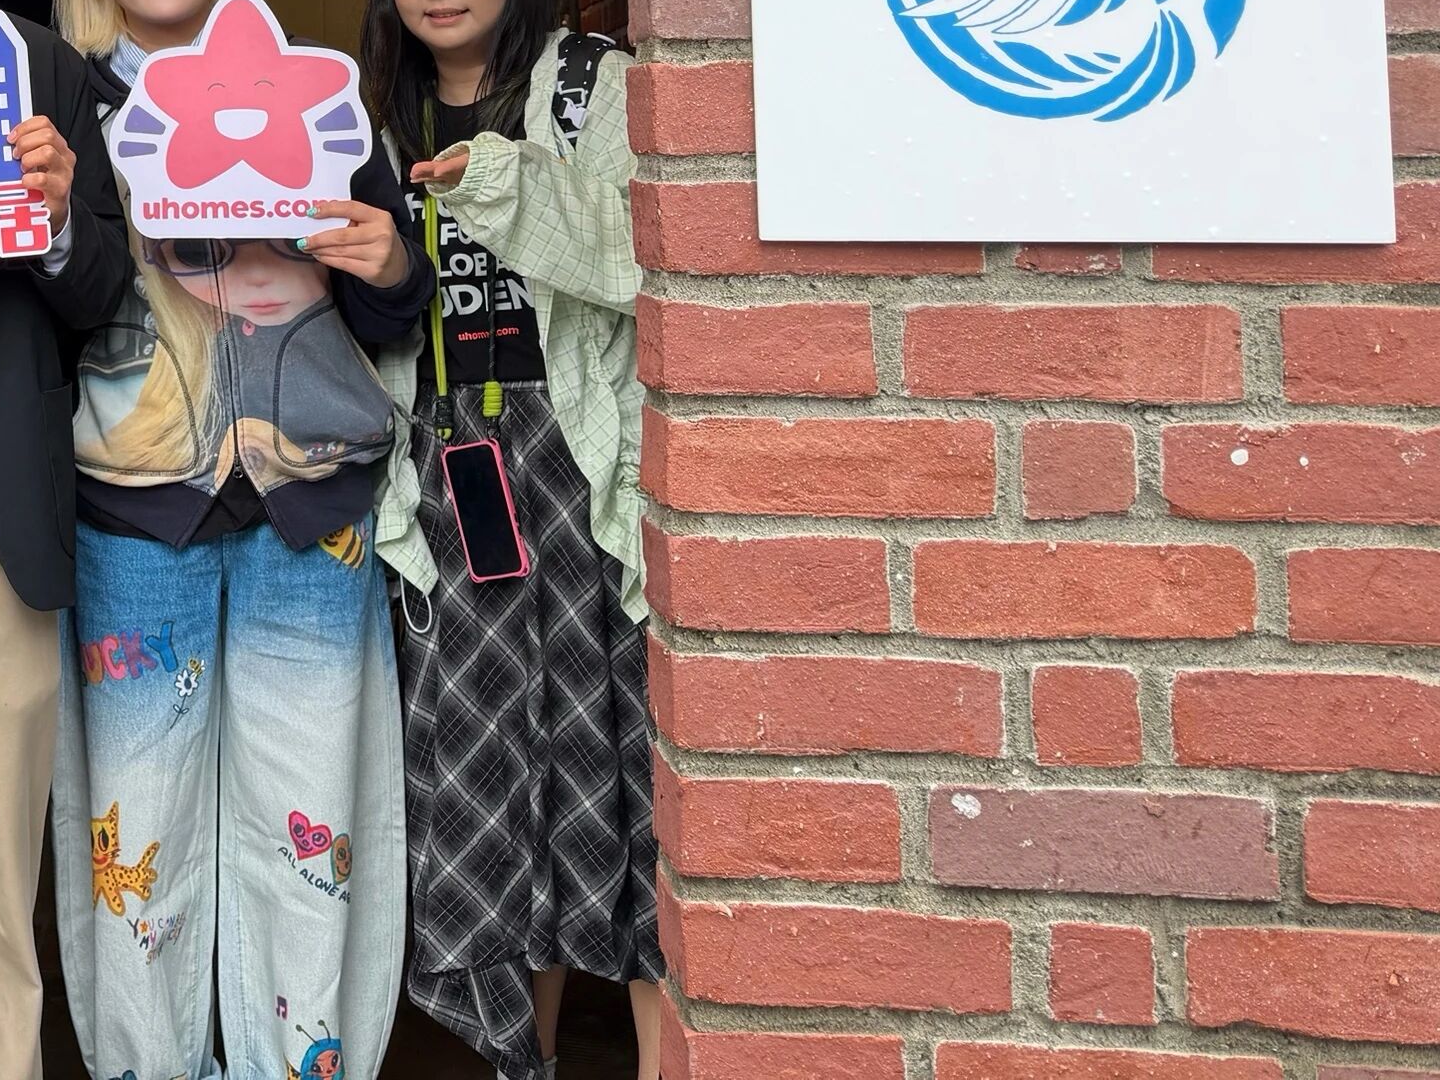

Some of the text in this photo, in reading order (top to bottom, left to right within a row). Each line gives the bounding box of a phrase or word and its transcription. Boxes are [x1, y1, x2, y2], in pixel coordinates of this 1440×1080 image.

[79, 621, 179, 687] UCKY
[278, 846, 297, 869] ALL
[299, 868, 339, 897] ALONE
